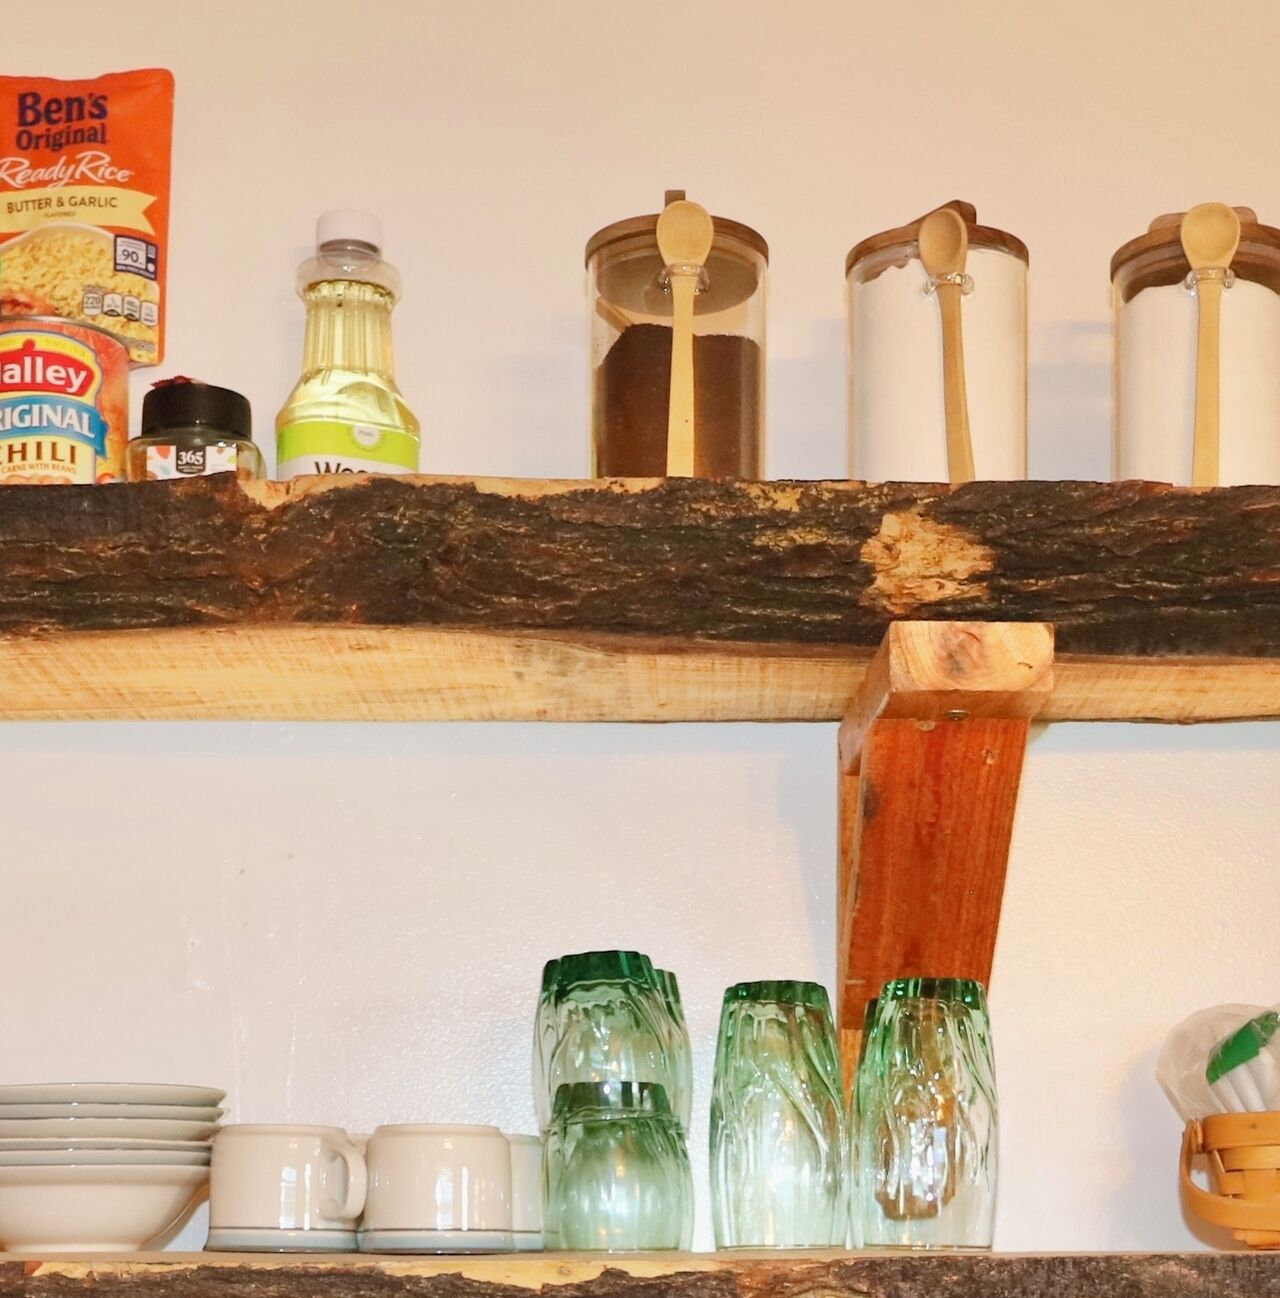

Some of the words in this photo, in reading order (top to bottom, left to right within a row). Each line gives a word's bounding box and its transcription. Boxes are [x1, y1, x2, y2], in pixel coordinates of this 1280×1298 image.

[17, 92, 108, 127] Ben's
[16, 123, 108, 152] Original
[72, 151, 130, 183] Rice
[7, 197, 52, 214] BUTTER
[56, 196, 64, 207] &
[68, 195, 118, 208] GARLIC
[121, 249, 139, 263] 90
[177, 450, 203, 465] 365
